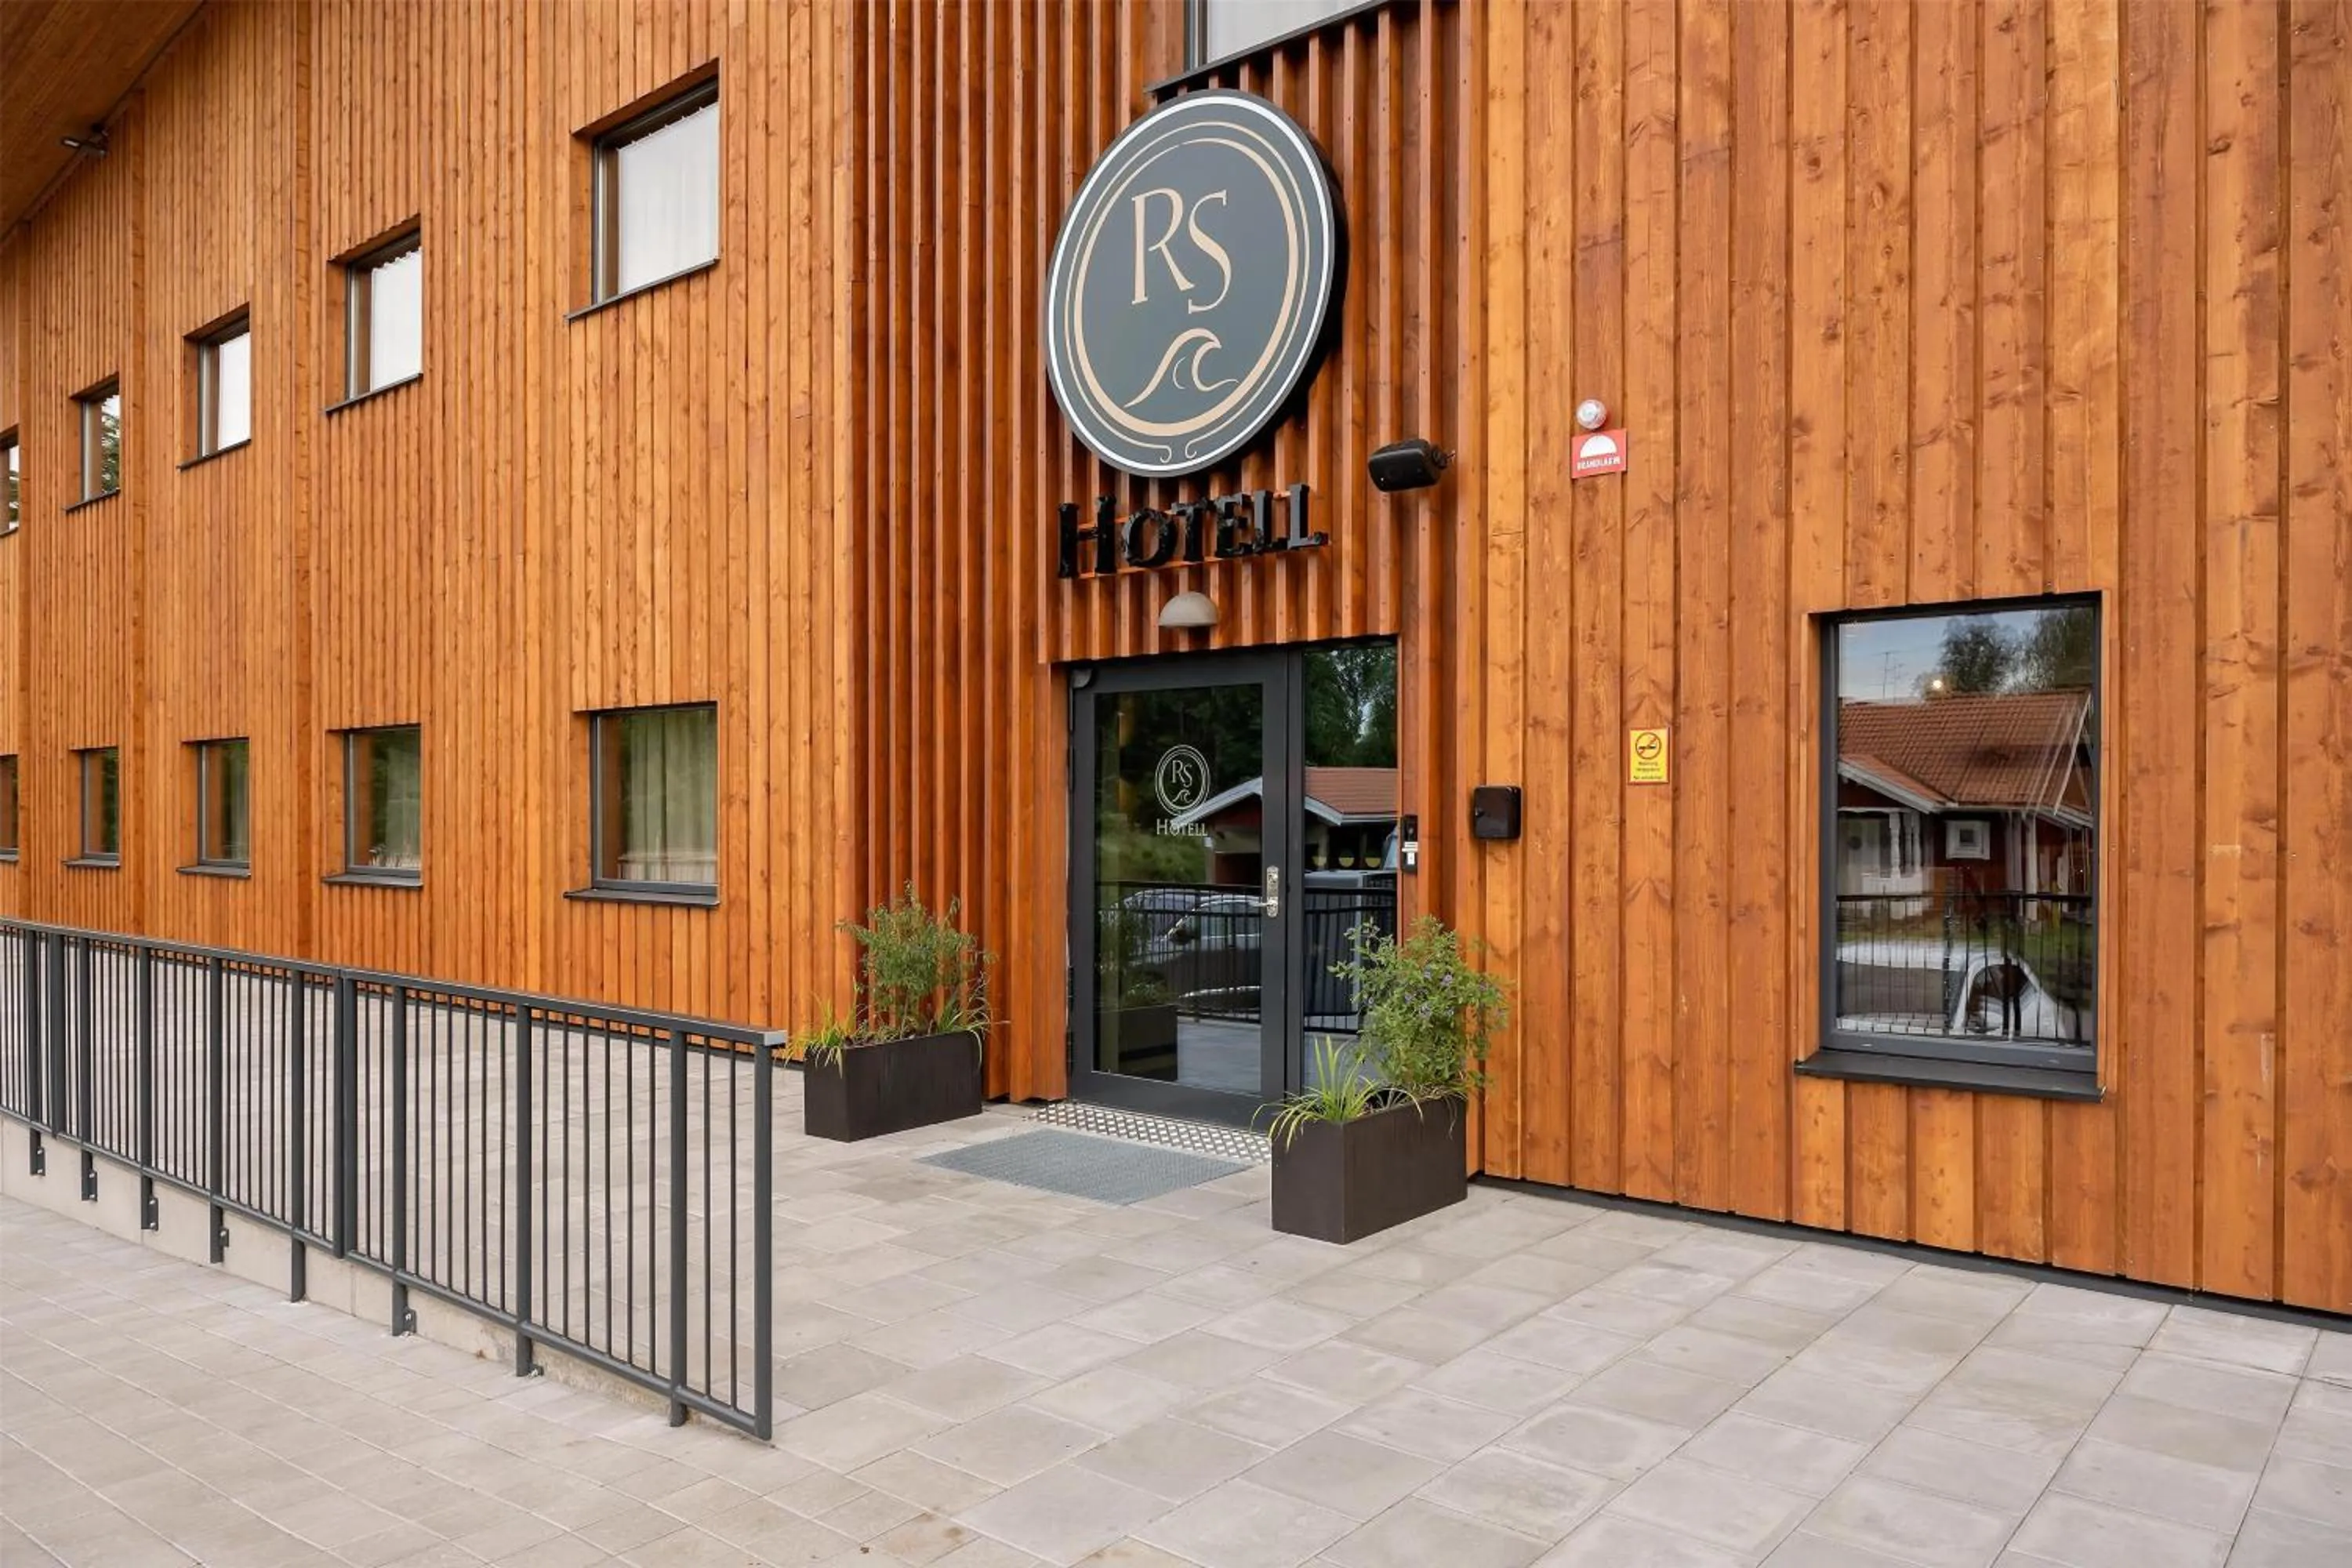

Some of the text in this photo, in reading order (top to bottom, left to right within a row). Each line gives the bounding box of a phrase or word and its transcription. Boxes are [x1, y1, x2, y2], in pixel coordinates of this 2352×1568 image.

[1131, 187, 1232, 314] RS
[1056, 483, 1330, 579] HOTELL
[1171, 760, 1192, 788] RS
